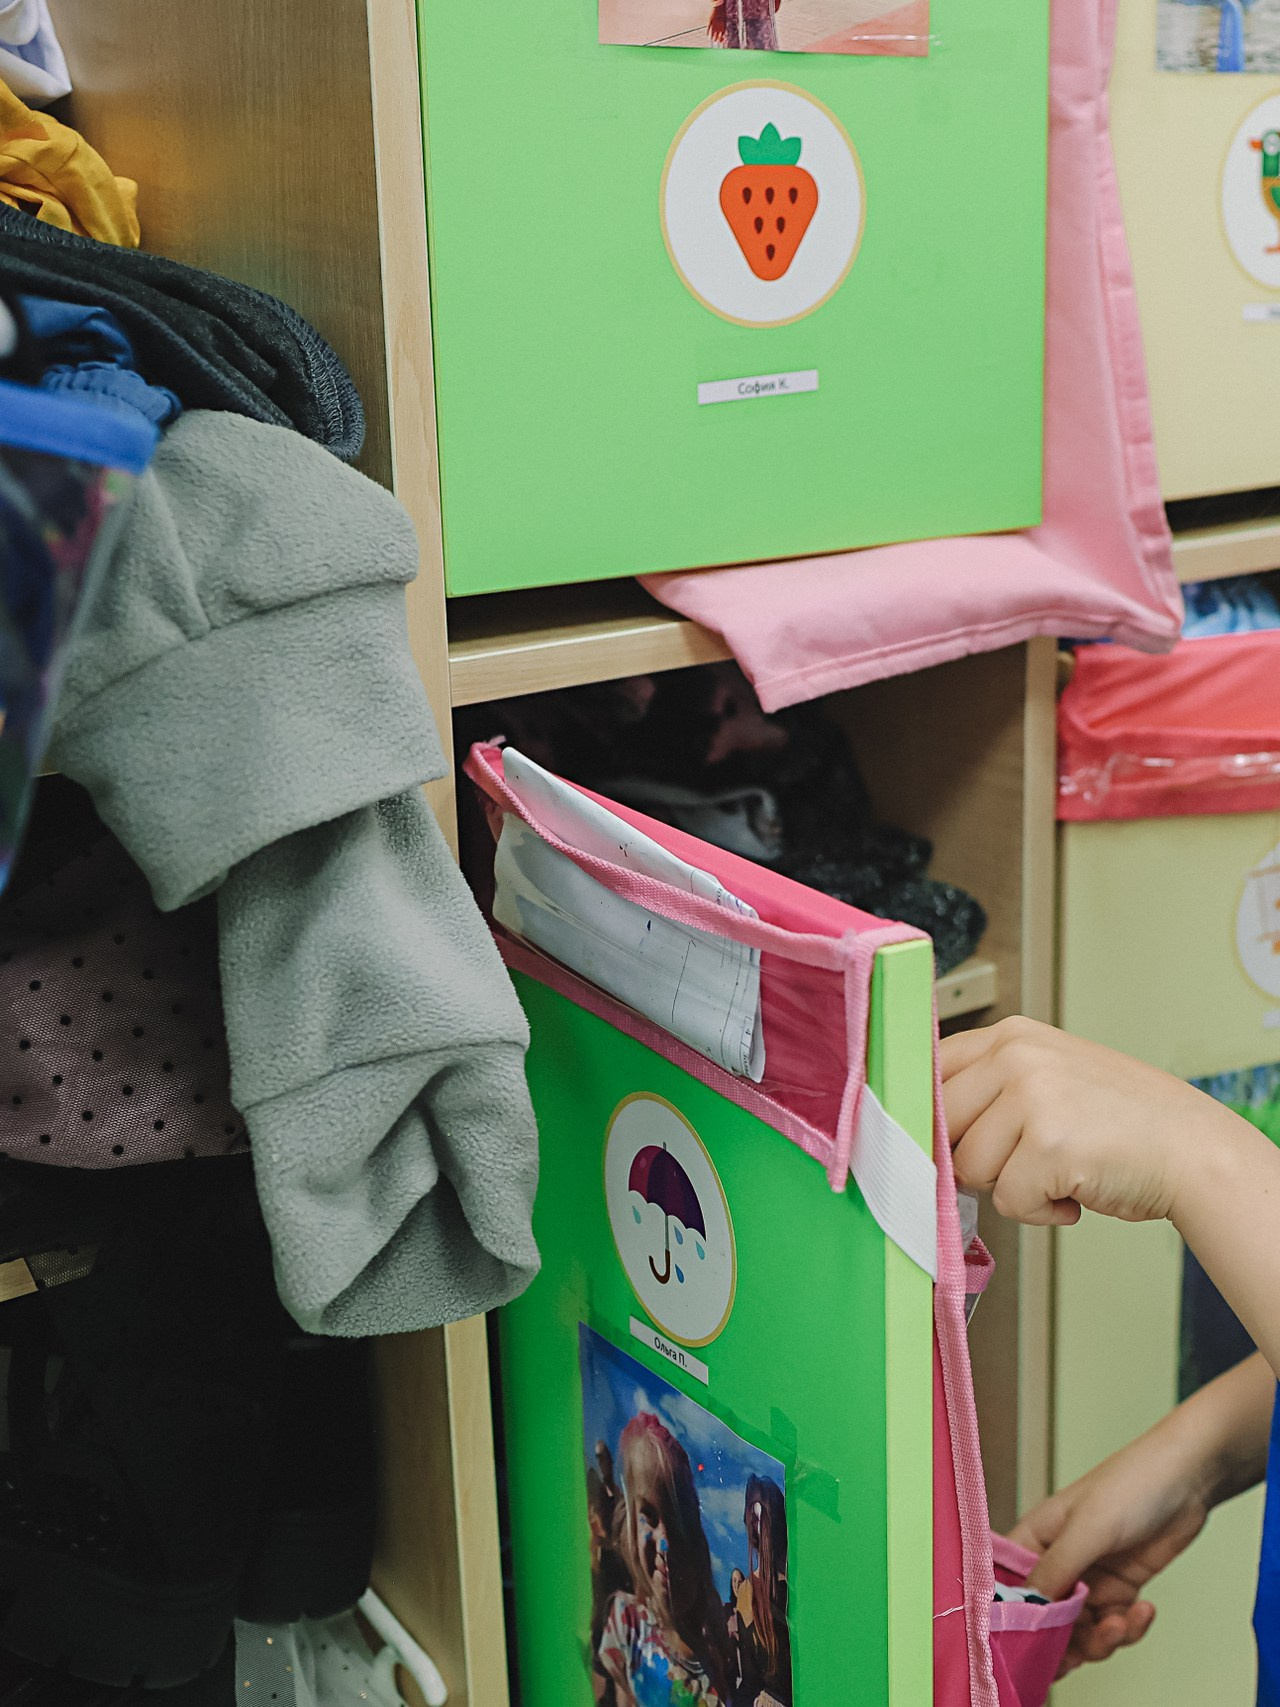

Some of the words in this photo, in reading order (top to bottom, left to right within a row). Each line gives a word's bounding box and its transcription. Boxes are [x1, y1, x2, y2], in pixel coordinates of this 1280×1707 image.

[737, 381, 776, 395] София
[654, 1336, 677, 1360] Ольга
[678, 1352, 688, 1367] П.
